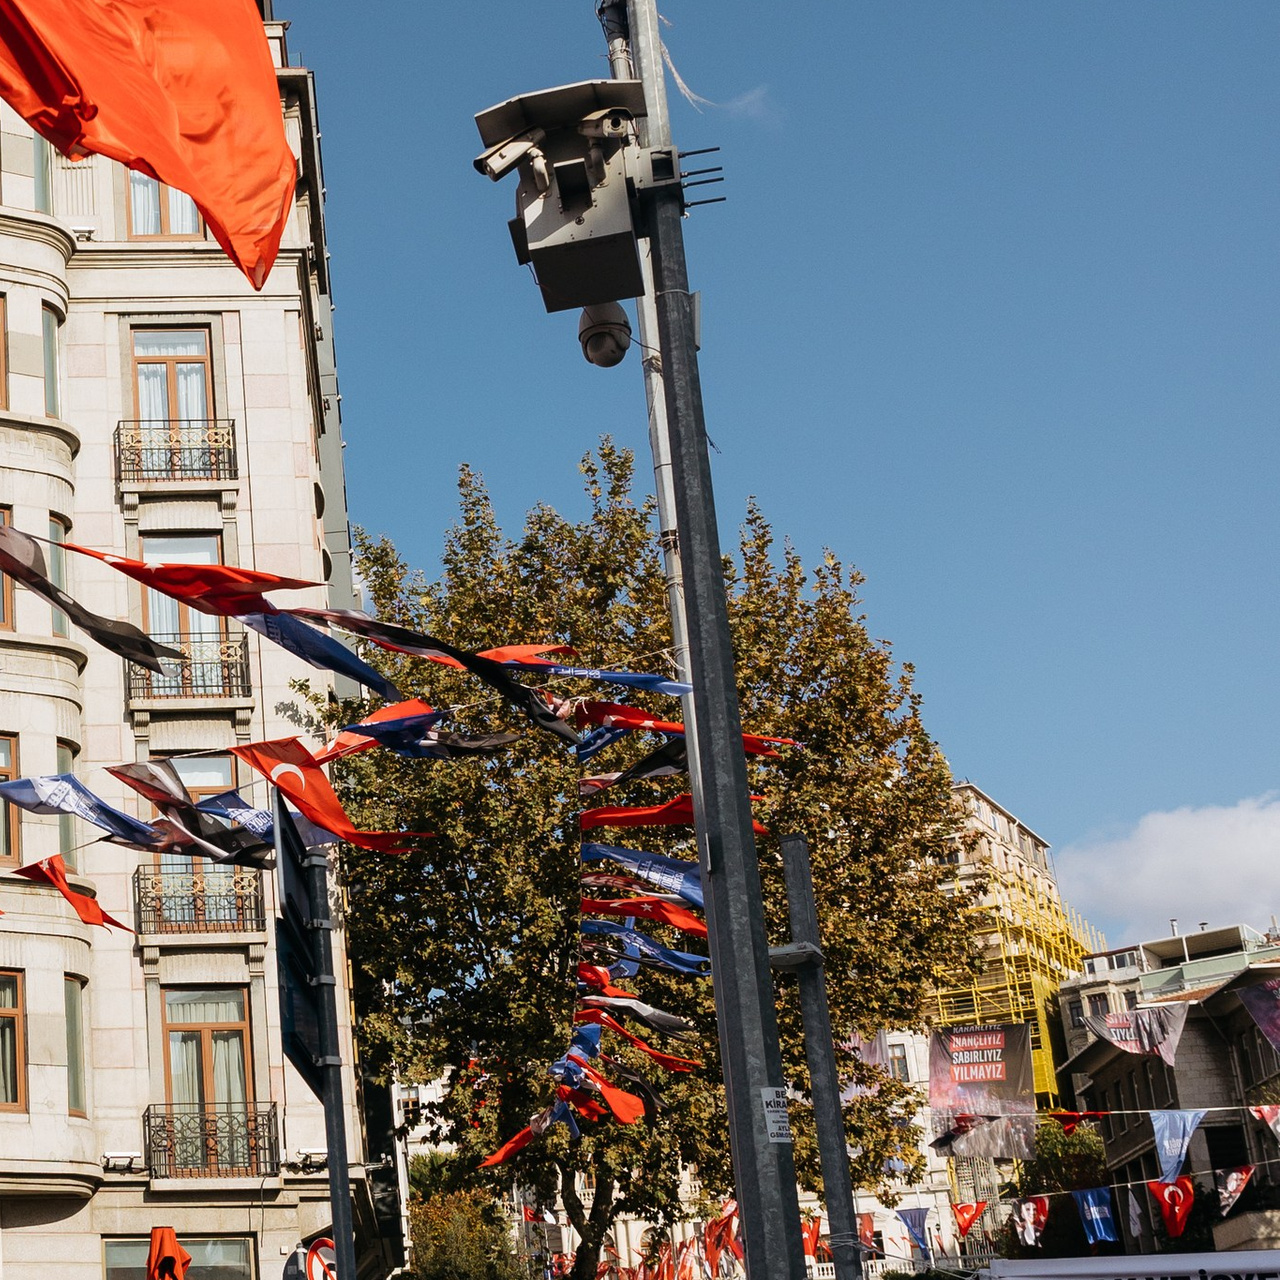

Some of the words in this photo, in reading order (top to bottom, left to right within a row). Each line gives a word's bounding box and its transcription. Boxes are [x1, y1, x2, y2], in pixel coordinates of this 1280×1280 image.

[952, 1049, 1002, 1065] SABIRLIYIZ
[953, 1064, 1003, 1081] YILMAYIZ
[765, 1098, 787, 1109] KİRA
